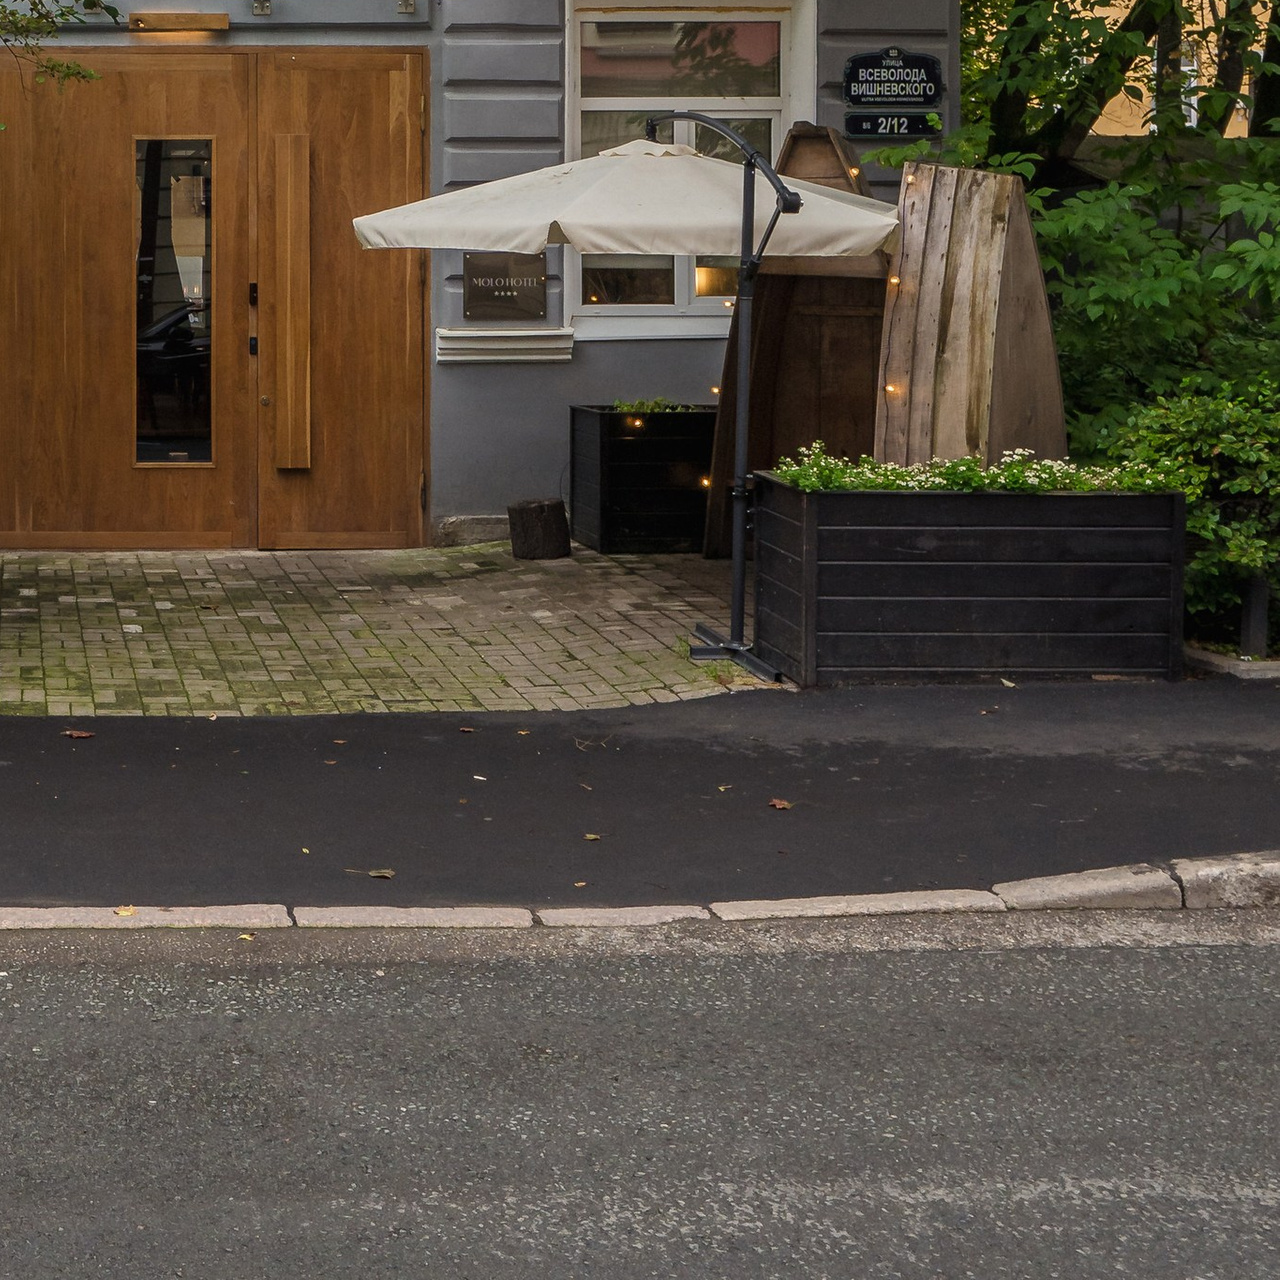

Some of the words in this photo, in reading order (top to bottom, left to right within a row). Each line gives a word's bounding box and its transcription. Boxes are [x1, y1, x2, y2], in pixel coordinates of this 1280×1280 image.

[859, 69, 927, 82] ВСЕВОЛОДА
[851, 83, 935, 95] ВИШНЕВСКОГО
[878, 117, 908, 133] 2/12
[472, 278, 504, 286] MOLO
[506, 278, 537, 286] HOTEL
